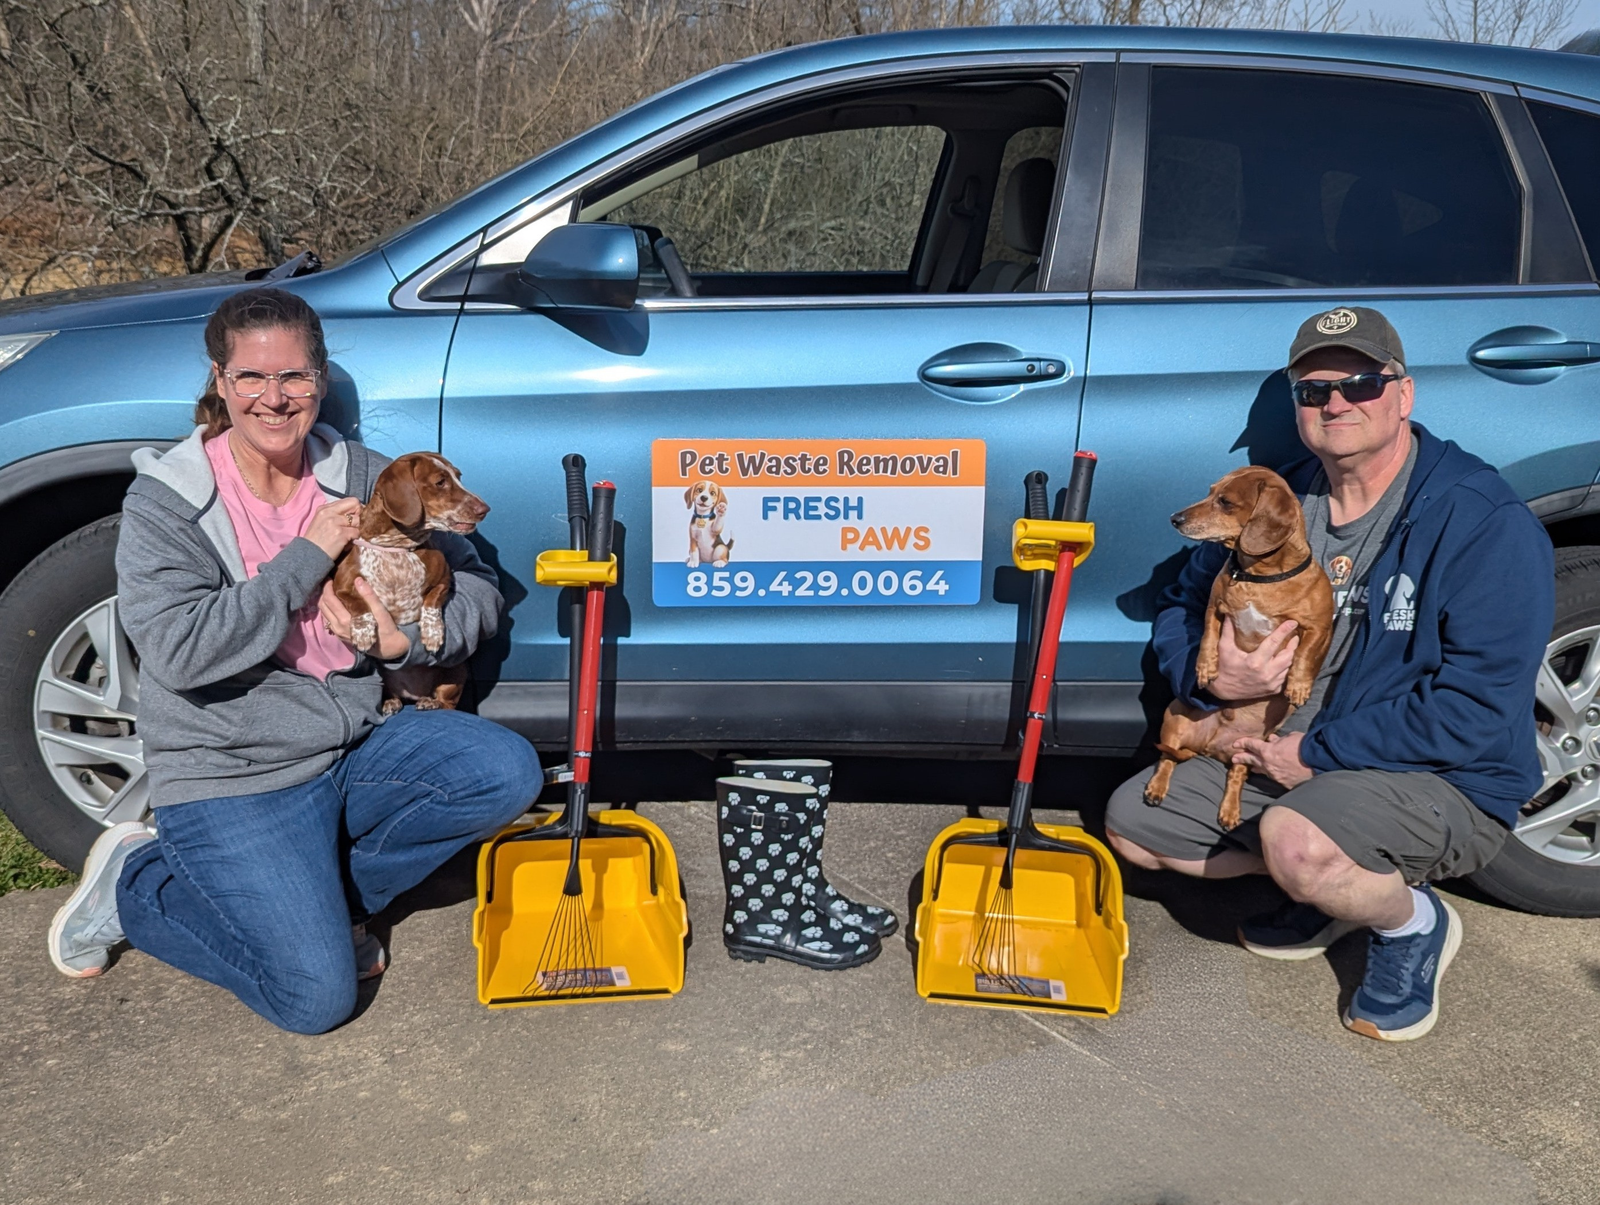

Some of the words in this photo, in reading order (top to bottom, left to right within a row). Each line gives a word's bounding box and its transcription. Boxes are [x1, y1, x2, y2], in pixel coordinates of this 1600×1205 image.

[679, 450, 730, 478] Pet
[737, 450, 829, 477] Waste
[837, 449, 960, 477] Removal
[762, 496, 864, 521] FRESH
[840, 526, 931, 551] PAWS
[686, 570, 949, 597] 859.429.0064
[1383, 609, 1415, 624] FESH
[1385, 620, 1414, 631] AWS
